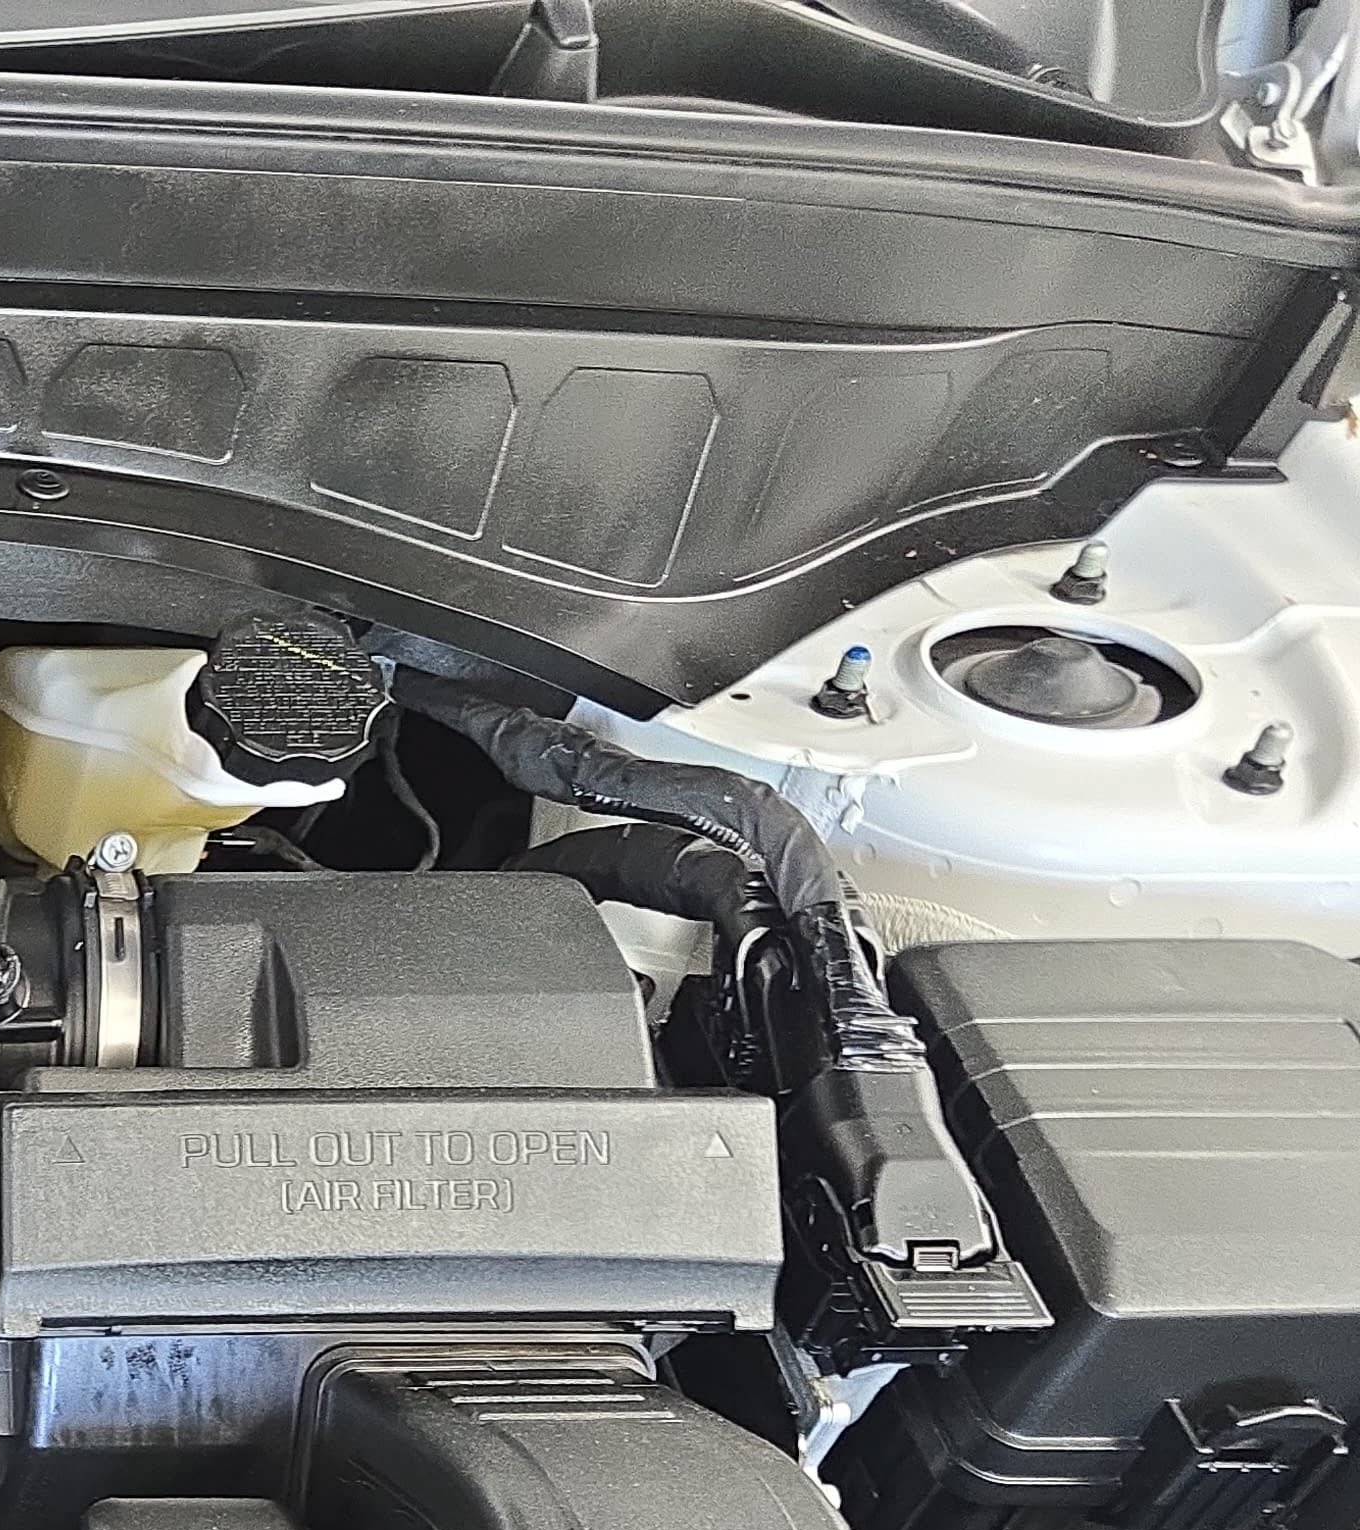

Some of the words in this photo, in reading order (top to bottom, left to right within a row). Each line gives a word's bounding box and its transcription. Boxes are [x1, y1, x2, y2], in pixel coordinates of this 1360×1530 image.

[180, 1131, 296, 1168] PULL
[308, 1130, 401, 1167] OUT
[416, 1130, 475, 1166] TO
[487, 1129, 611, 1166] OPEN
[281, 1179, 361, 1214] (AIR
[372, 1178, 514, 1213] FILTER)
